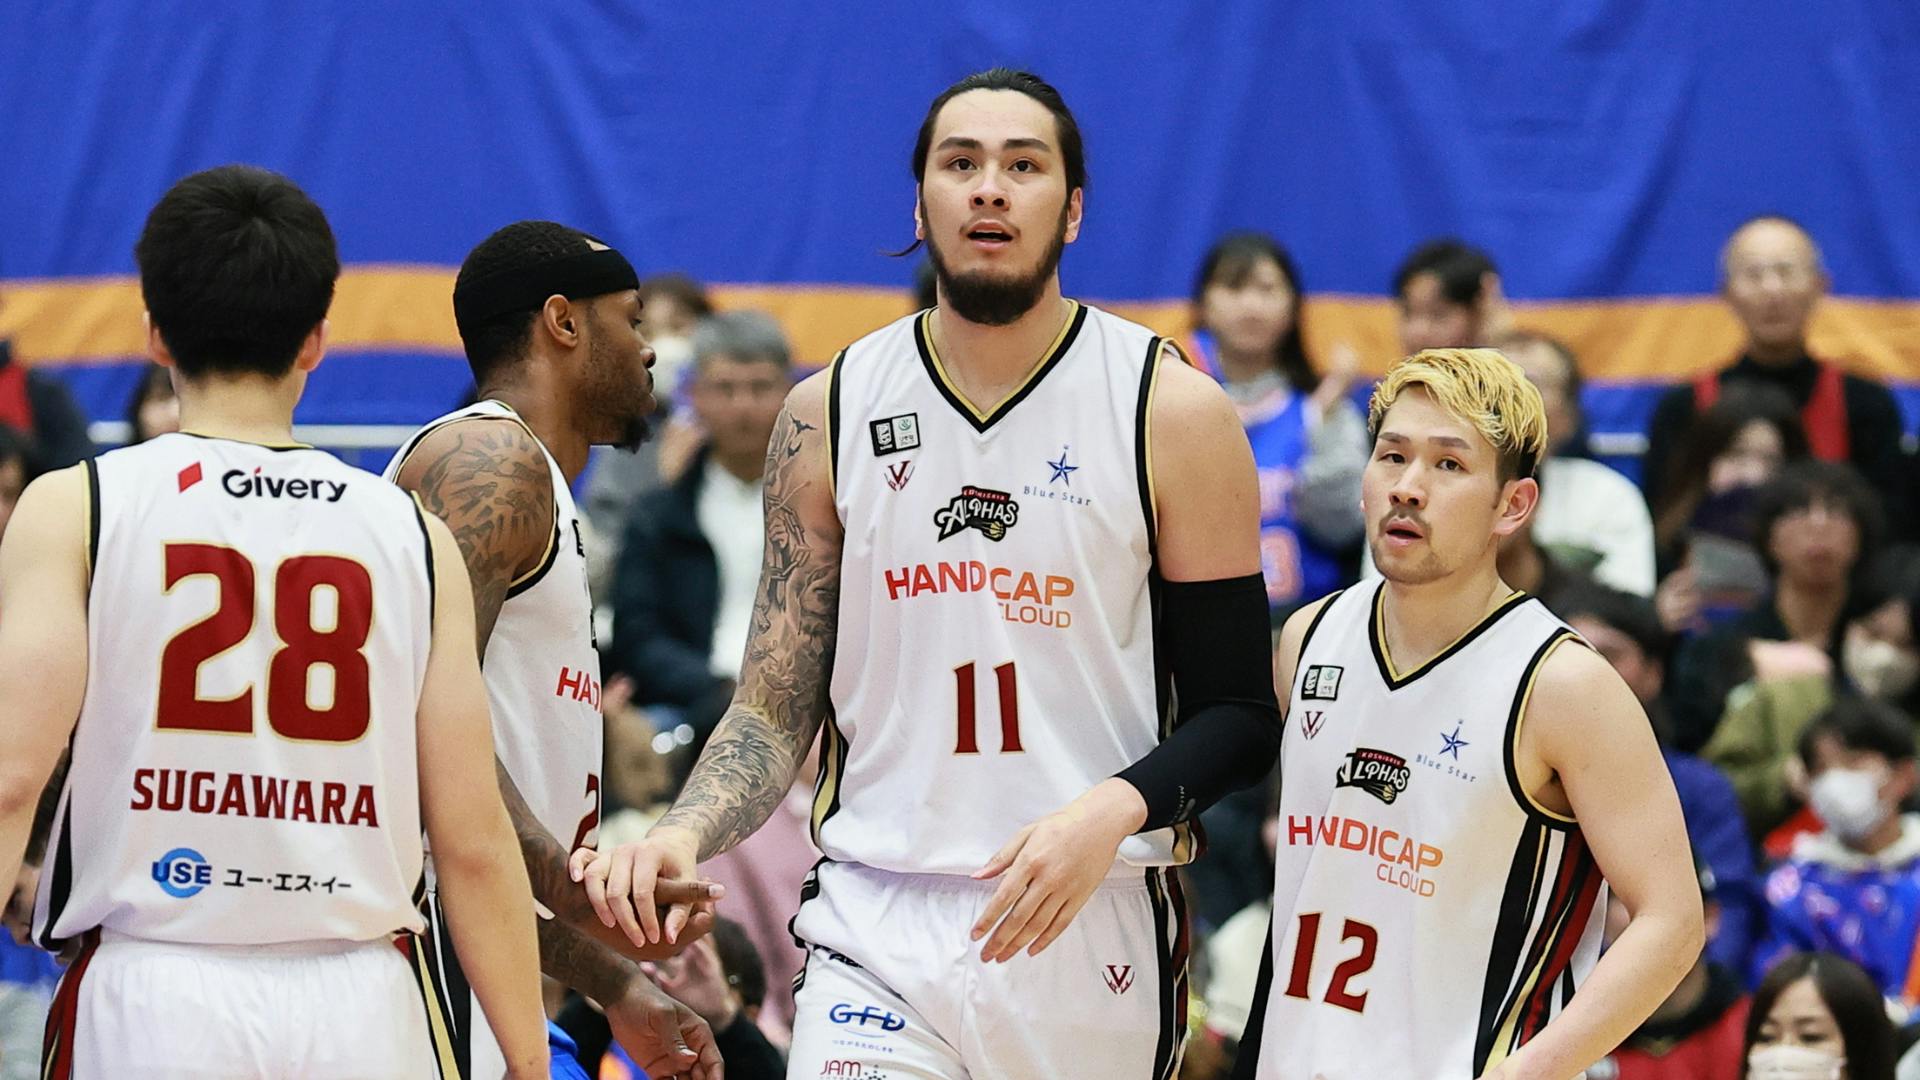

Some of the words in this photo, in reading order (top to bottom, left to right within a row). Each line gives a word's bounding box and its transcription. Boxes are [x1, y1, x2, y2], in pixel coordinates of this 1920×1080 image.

[221, 465, 348, 503] Givery
[1023, 484, 1055, 499] Blue
[1062, 491, 1092, 506] Star
[936, 498, 1018, 535] ALPHAS
[884, 560, 1075, 607] HANDCAP
[152, 539, 376, 745] 28
[952, 659, 1026, 756] 11
[1416, 753, 1442, 770] Blue
[1447, 765, 1477, 783] Star
[130, 767, 380, 829] SUGAWARA
[1288, 815, 1444, 873] HNDICAP
[152, 861, 213, 885] USE
[223, 868, 352, 895] ユー・エス・イー
[1376, 863, 1436, 898] CLOUD
[1284, 910, 1379, 1015] 12
[829, 1003, 906, 1032] GFD
[820, 1059, 861, 1078] JAM
